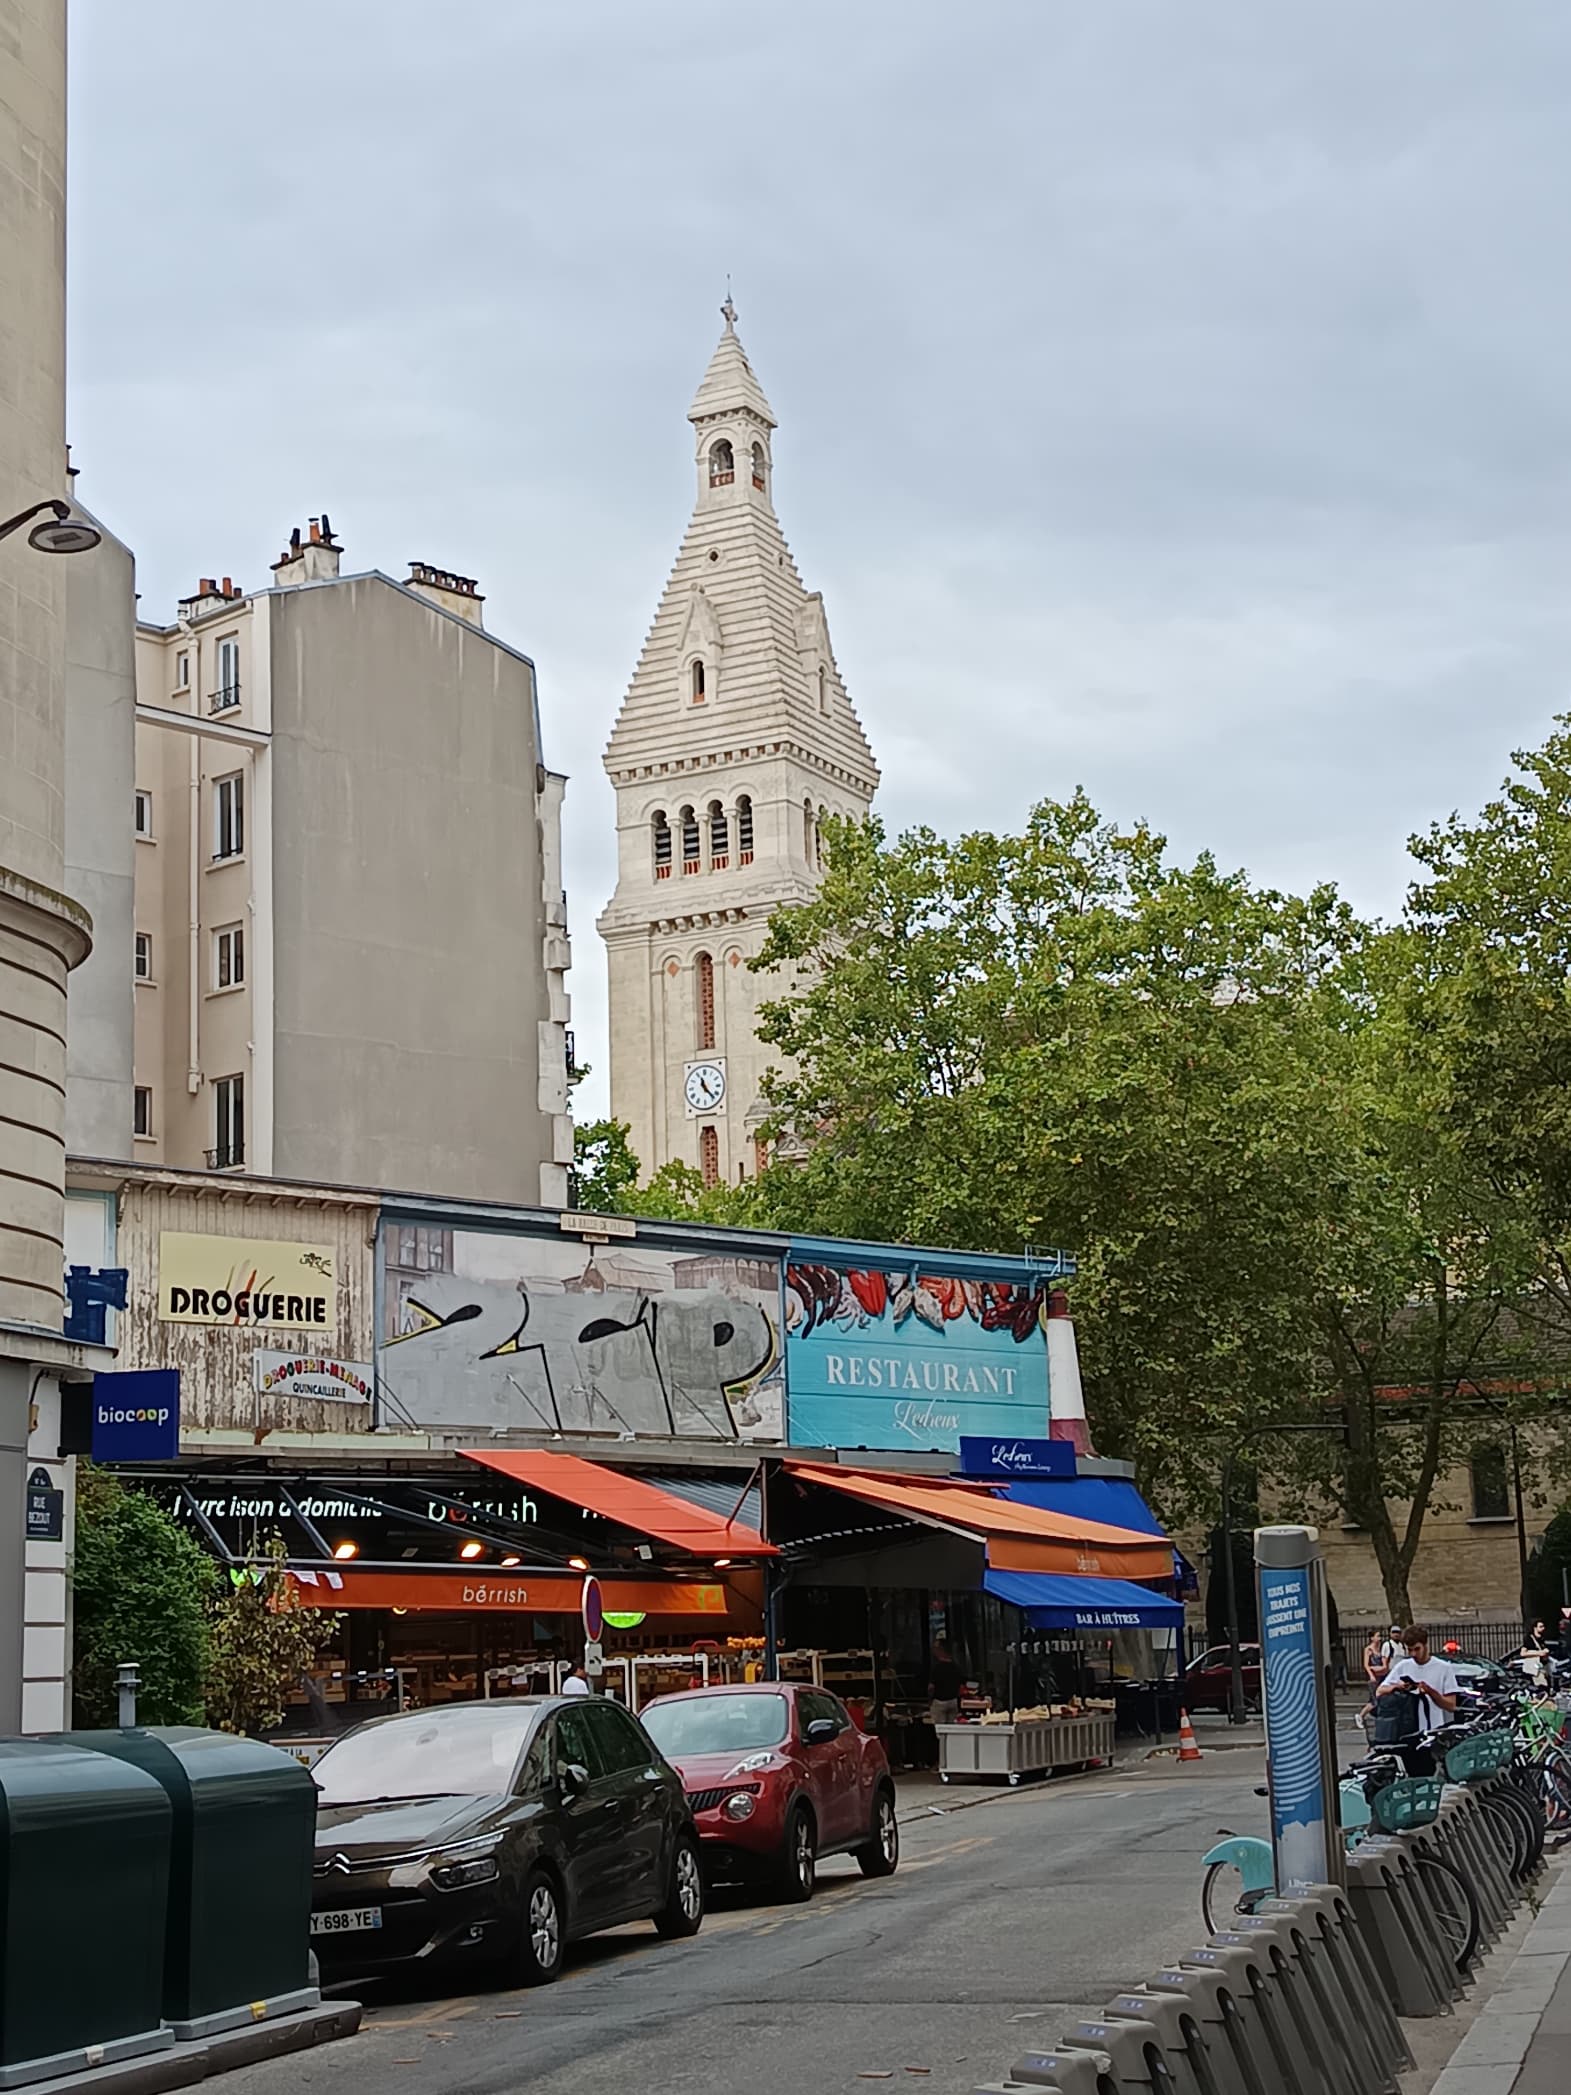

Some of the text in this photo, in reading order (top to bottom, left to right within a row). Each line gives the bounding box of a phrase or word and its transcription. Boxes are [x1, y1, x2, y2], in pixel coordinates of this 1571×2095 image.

[170, 1286, 326, 1323] DROGUERIE
[826, 1354, 1017, 1395] RESTAURANT
[292, 1382, 346, 1398] QUINCAILLERIE
[98, 1405, 169, 1426] biocoop
[1076, 1613, 1094, 1624] BAR
